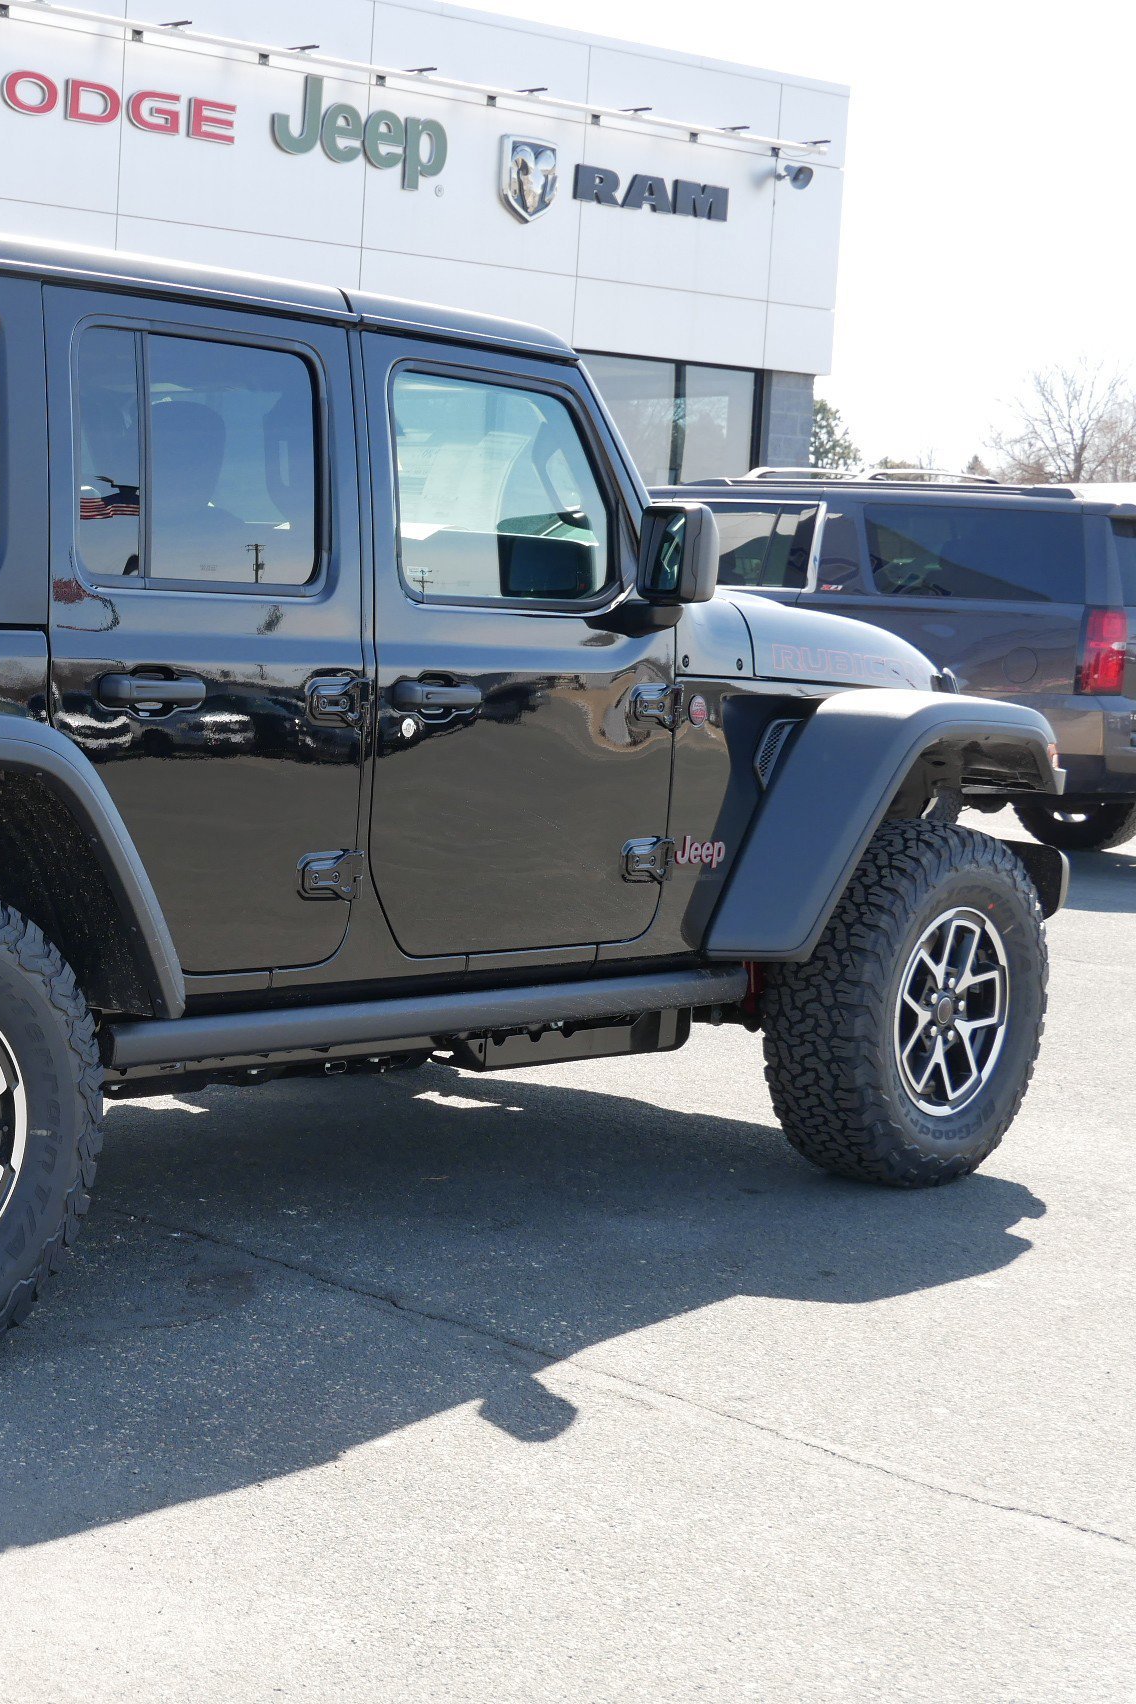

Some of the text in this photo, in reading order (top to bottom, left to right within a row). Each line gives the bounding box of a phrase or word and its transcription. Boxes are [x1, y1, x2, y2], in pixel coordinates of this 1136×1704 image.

[271, 74, 448, 190] Jeep
[573, 163, 729, 222] RAM
[674, 836, 725, 868] Jeep
